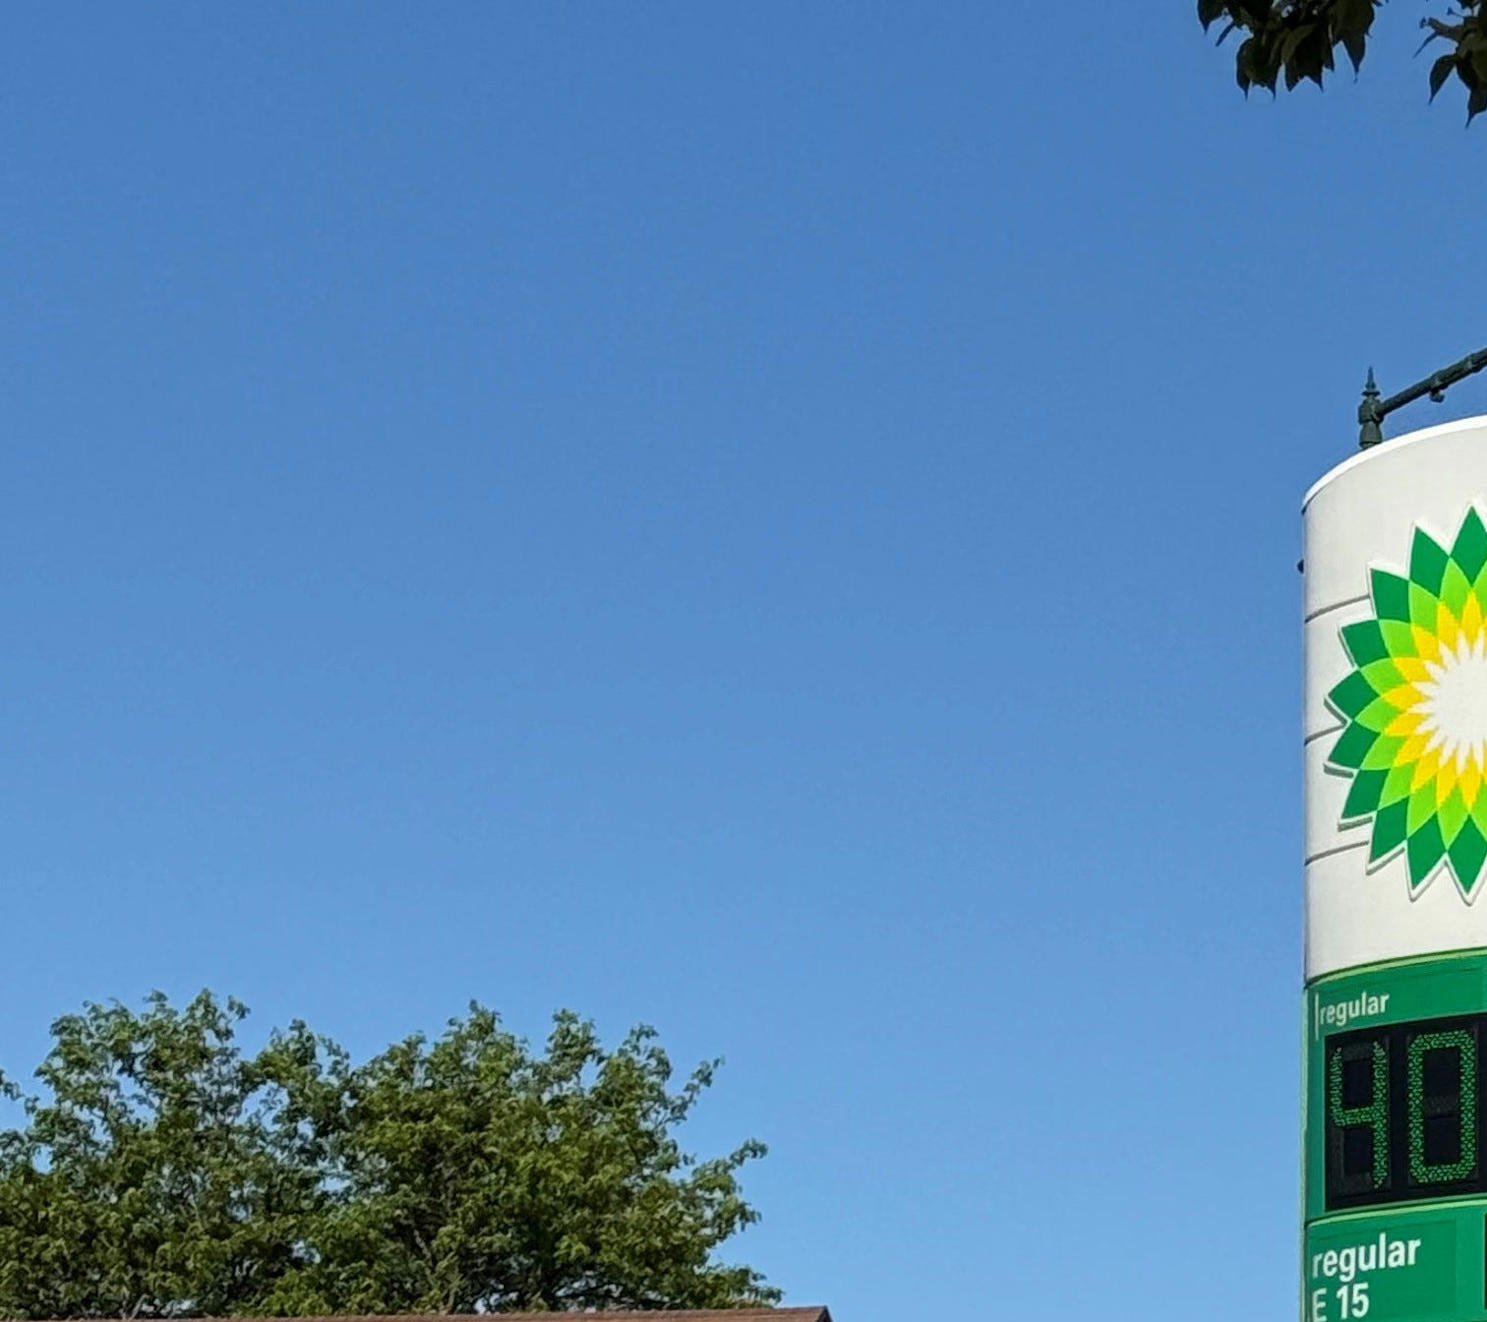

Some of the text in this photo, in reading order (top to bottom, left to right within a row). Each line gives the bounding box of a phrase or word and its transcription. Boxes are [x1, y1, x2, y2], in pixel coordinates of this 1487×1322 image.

[1320, 990, 1390, 1027] regular
[1312, 1232, 1422, 1282] regular
[1336, 1282, 1370, 1320] 15
